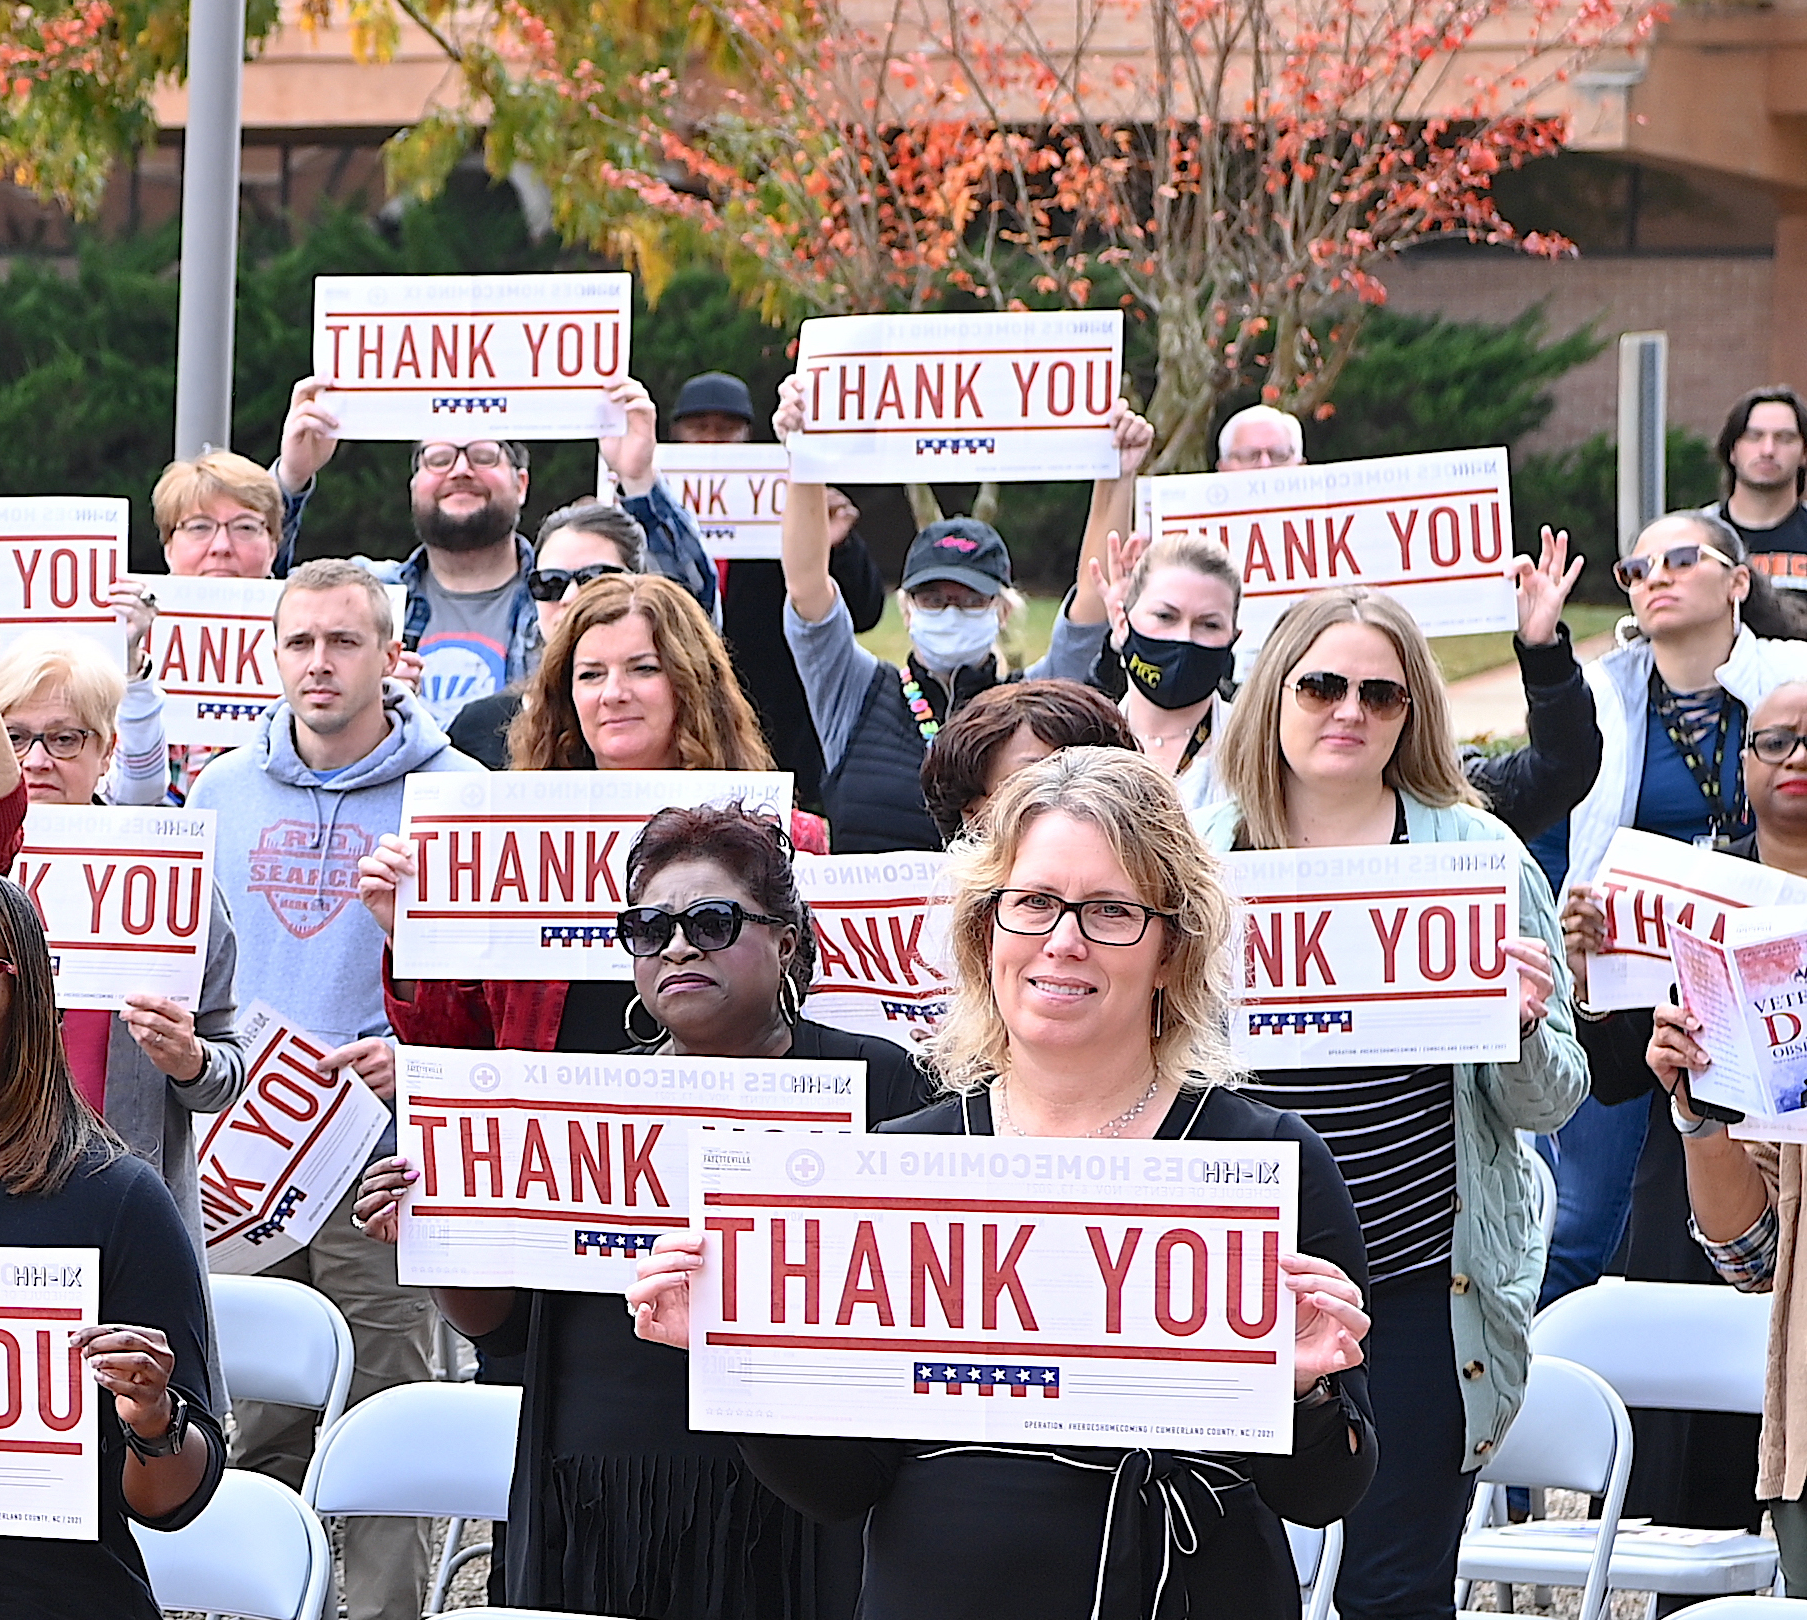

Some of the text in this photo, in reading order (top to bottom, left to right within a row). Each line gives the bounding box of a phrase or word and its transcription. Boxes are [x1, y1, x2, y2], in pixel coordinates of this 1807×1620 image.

[326, 322, 619, 378] THANK YOU
[808, 360, 1112, 420] THANK YOU
[749, 479, 787, 515] YO
[1387, 502, 1502, 571] YOU
[15, 549, 117, 609] YOU
[143, 625, 264, 685] ANK
[83, 864, 203, 938] YOU
[409, 831, 621, 903] THANK
[809, 915, 948, 986] ANK
[1369, 904, 1507, 984] YOU
[230, 1035, 338, 1151] YOU
[410, 1115, 670, 1208] THANK
[1203, 1161, 1280, 1184] HH-IX
[14, 1265, 82, 1287] HH-IX
[706, 1218, 1278, 1339] THANK YOU
